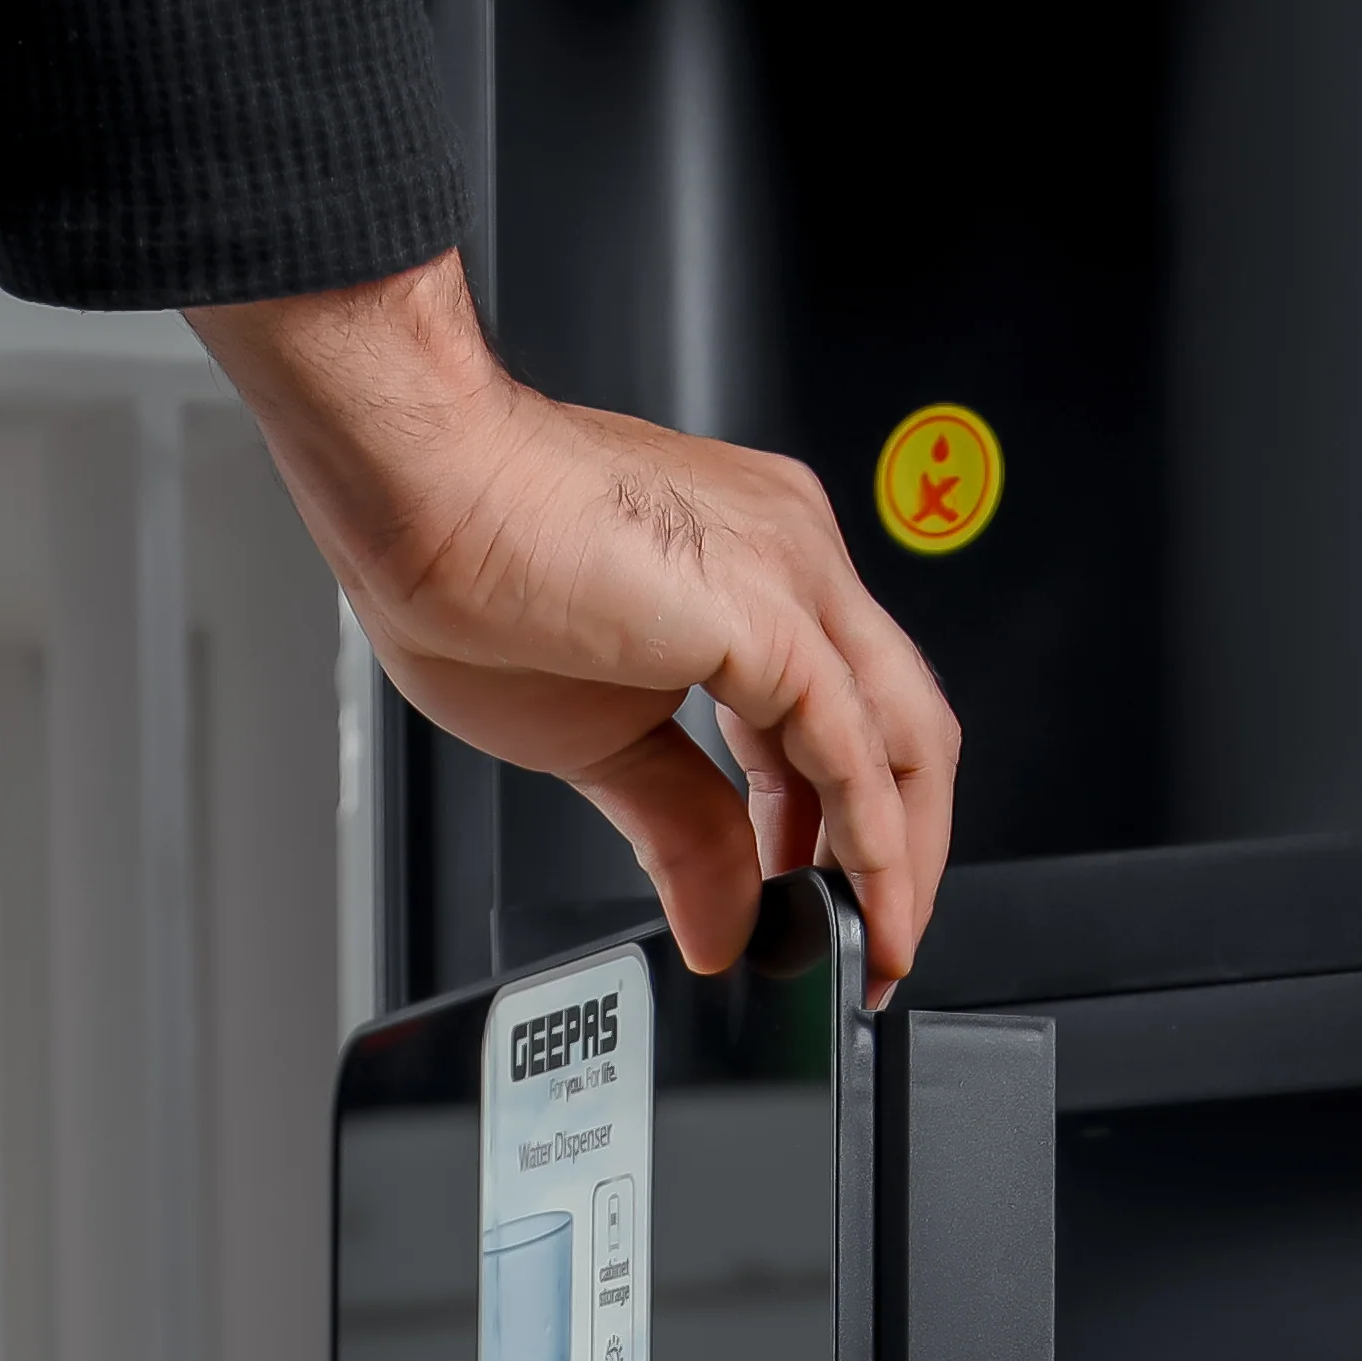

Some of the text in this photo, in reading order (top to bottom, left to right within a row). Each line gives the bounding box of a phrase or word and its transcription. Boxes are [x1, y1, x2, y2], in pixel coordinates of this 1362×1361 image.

[511, 991, 619, 1083] GEEPAS
[518, 1122, 614, 1171] Water Dispenser
[599, 1257, 631, 1284] cabinet
[599, 1284, 631, 1308] storage
